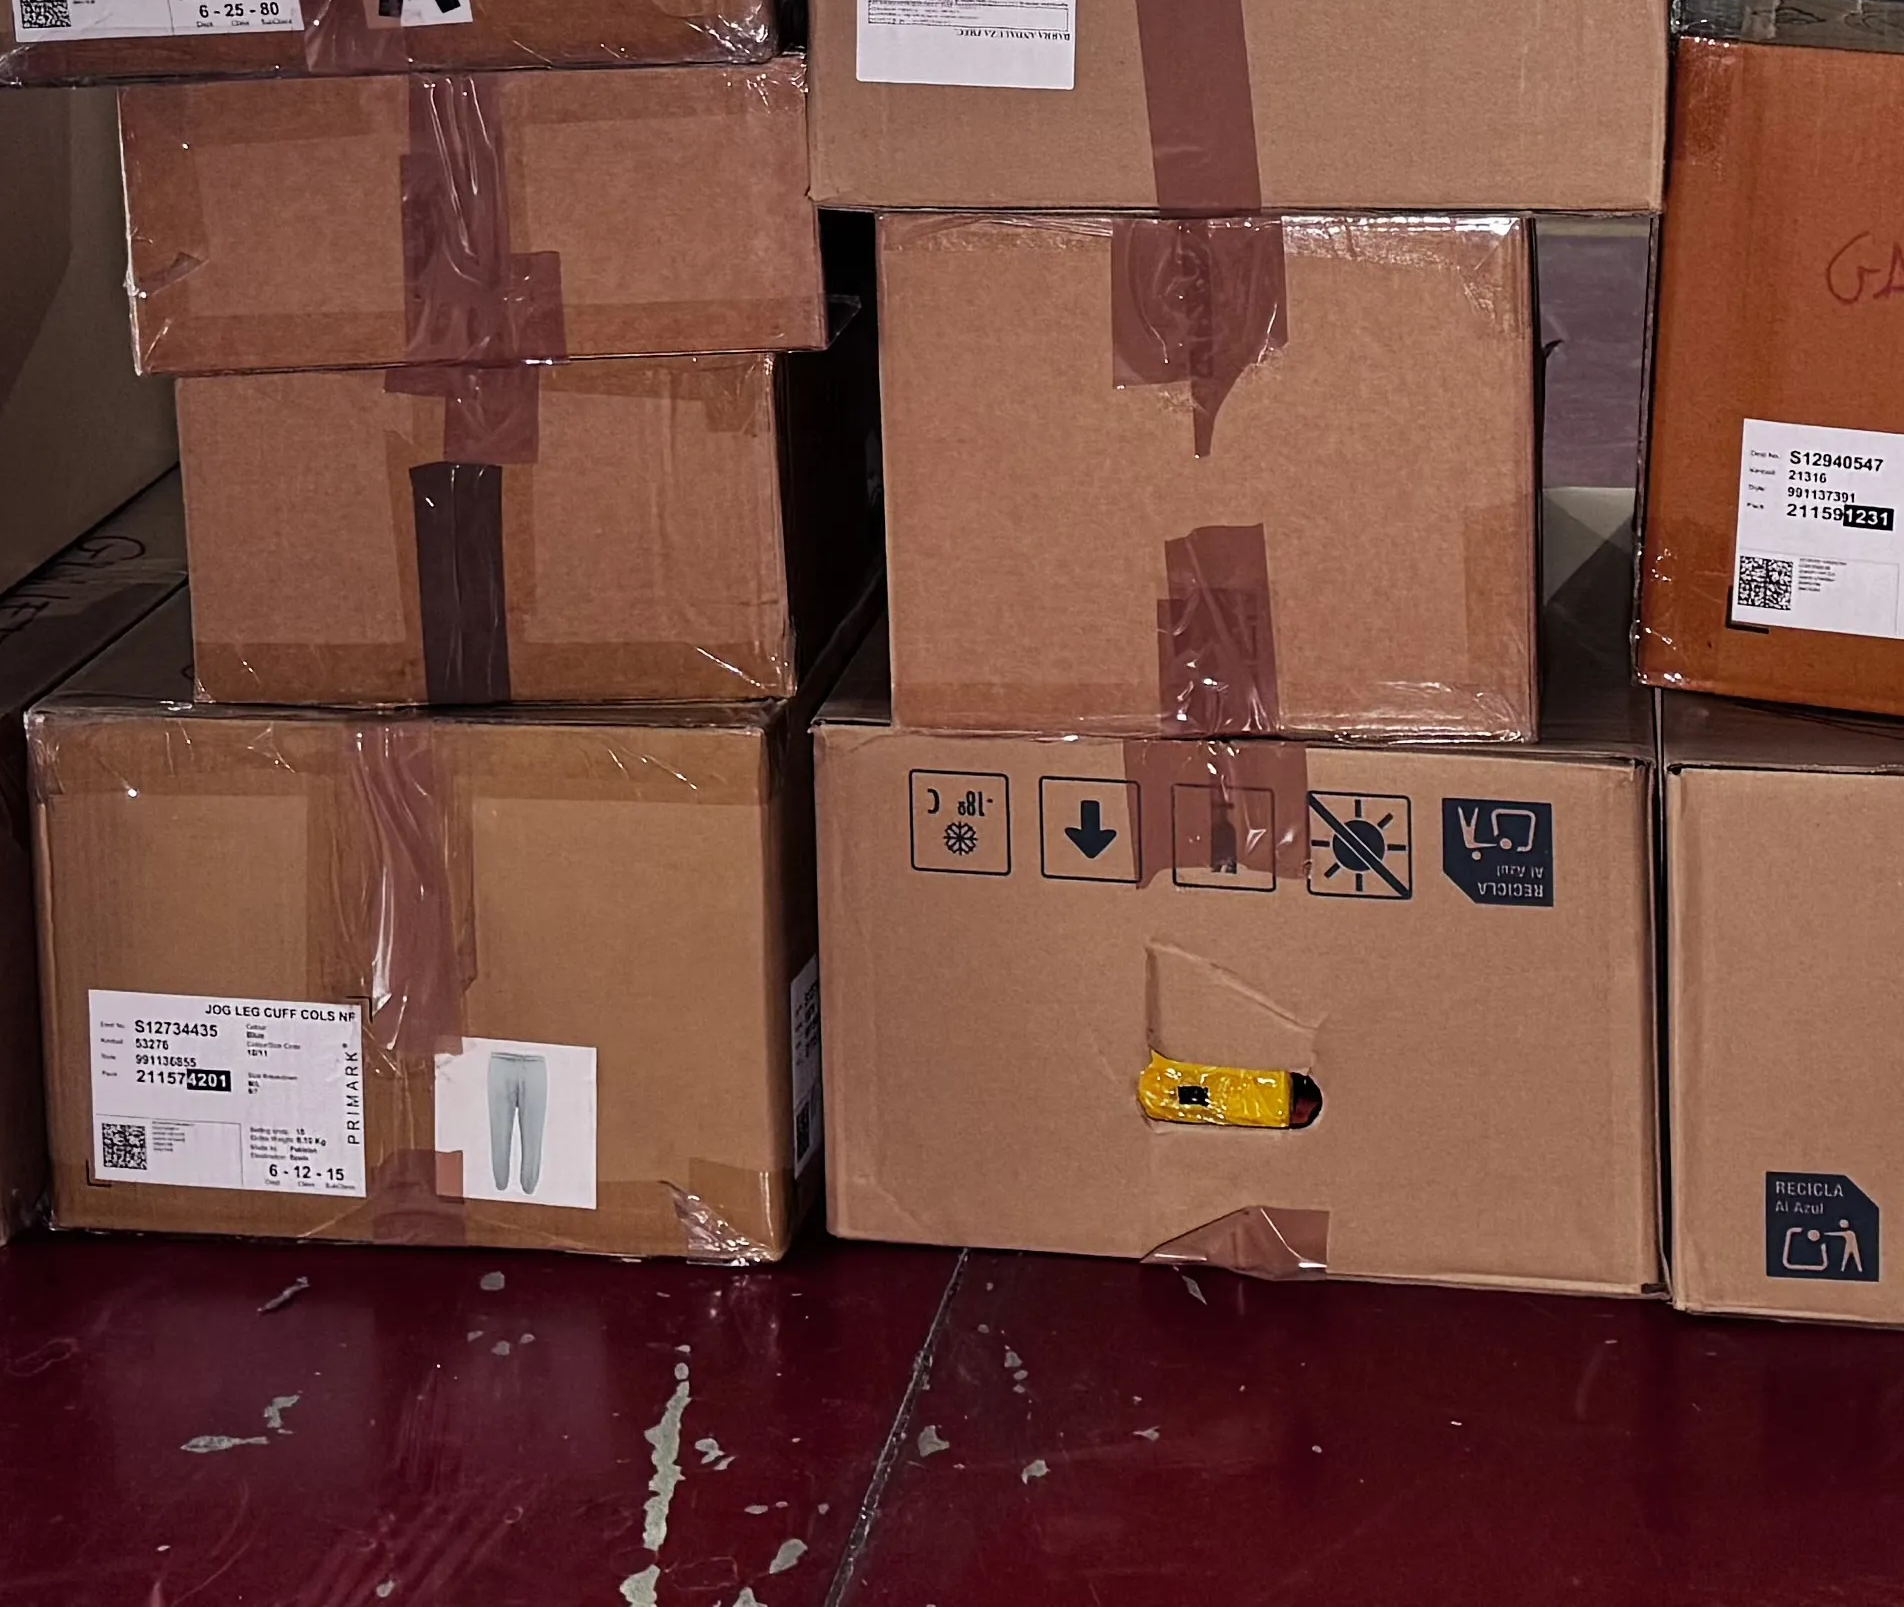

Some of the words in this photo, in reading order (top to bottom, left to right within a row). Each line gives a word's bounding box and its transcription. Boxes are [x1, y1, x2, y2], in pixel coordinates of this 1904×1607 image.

[199, 4, 209, 18] 6
[224, 3, 244, 17] 25
[260, 2, 279, 15] 80
[1790, 450, 1884, 472] S12940547
[1788, 469, 1827, 484] 21316
[1787, 487, 1855, 503] 991137391
[1786, 503, 1889, 526] 211591231
[1496, 865, 1526, 877] Azul
[1477, 882, 1544, 897] RECICLA
[205, 1005, 231, 1016] JOG
[235, 1006, 260, 1017] LEG
[264, 1007, 296, 1019] CUFF
[300, 1009, 335, 1021] COLS
[135, 1020, 218, 1037] S12734435
[135, 1038, 169, 1050] 53276
[136, 1070, 226, 1088] 211574201
[344, 1051, 360, 1145] PRIMARK
[269, 1164, 278, 1177] 6
[294, 1165, 311, 1179] 12
[326, 1167, 344, 1181] 15
[1775, 1181, 1844, 1197] RECICLA
[1794, 1201, 1824, 1214] Azul
